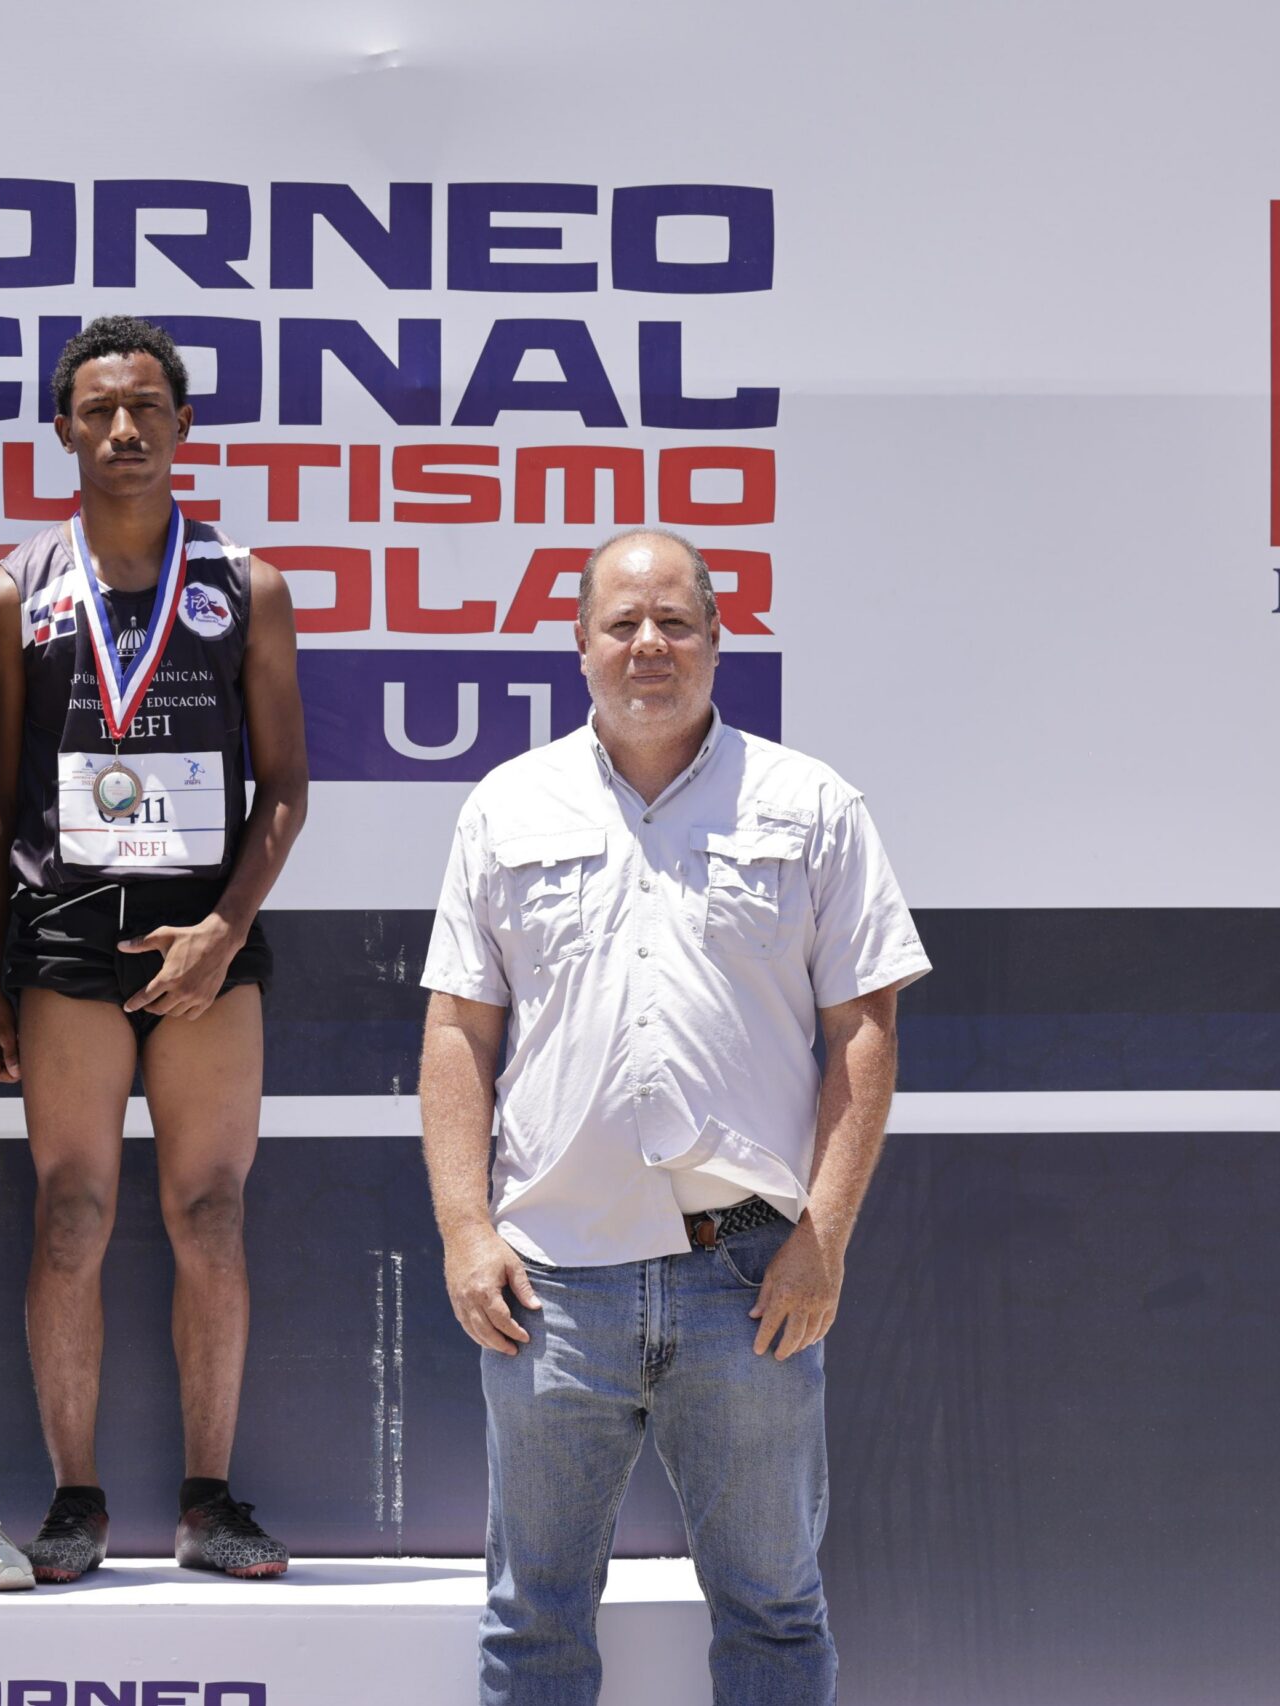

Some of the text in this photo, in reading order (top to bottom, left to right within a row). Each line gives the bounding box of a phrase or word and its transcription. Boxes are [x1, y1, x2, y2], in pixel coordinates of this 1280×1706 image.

[146, 692, 217, 708] EDUCACIÓN
[100, 715, 172, 739] IEFI
[117, 841, 168, 857] INEFI
